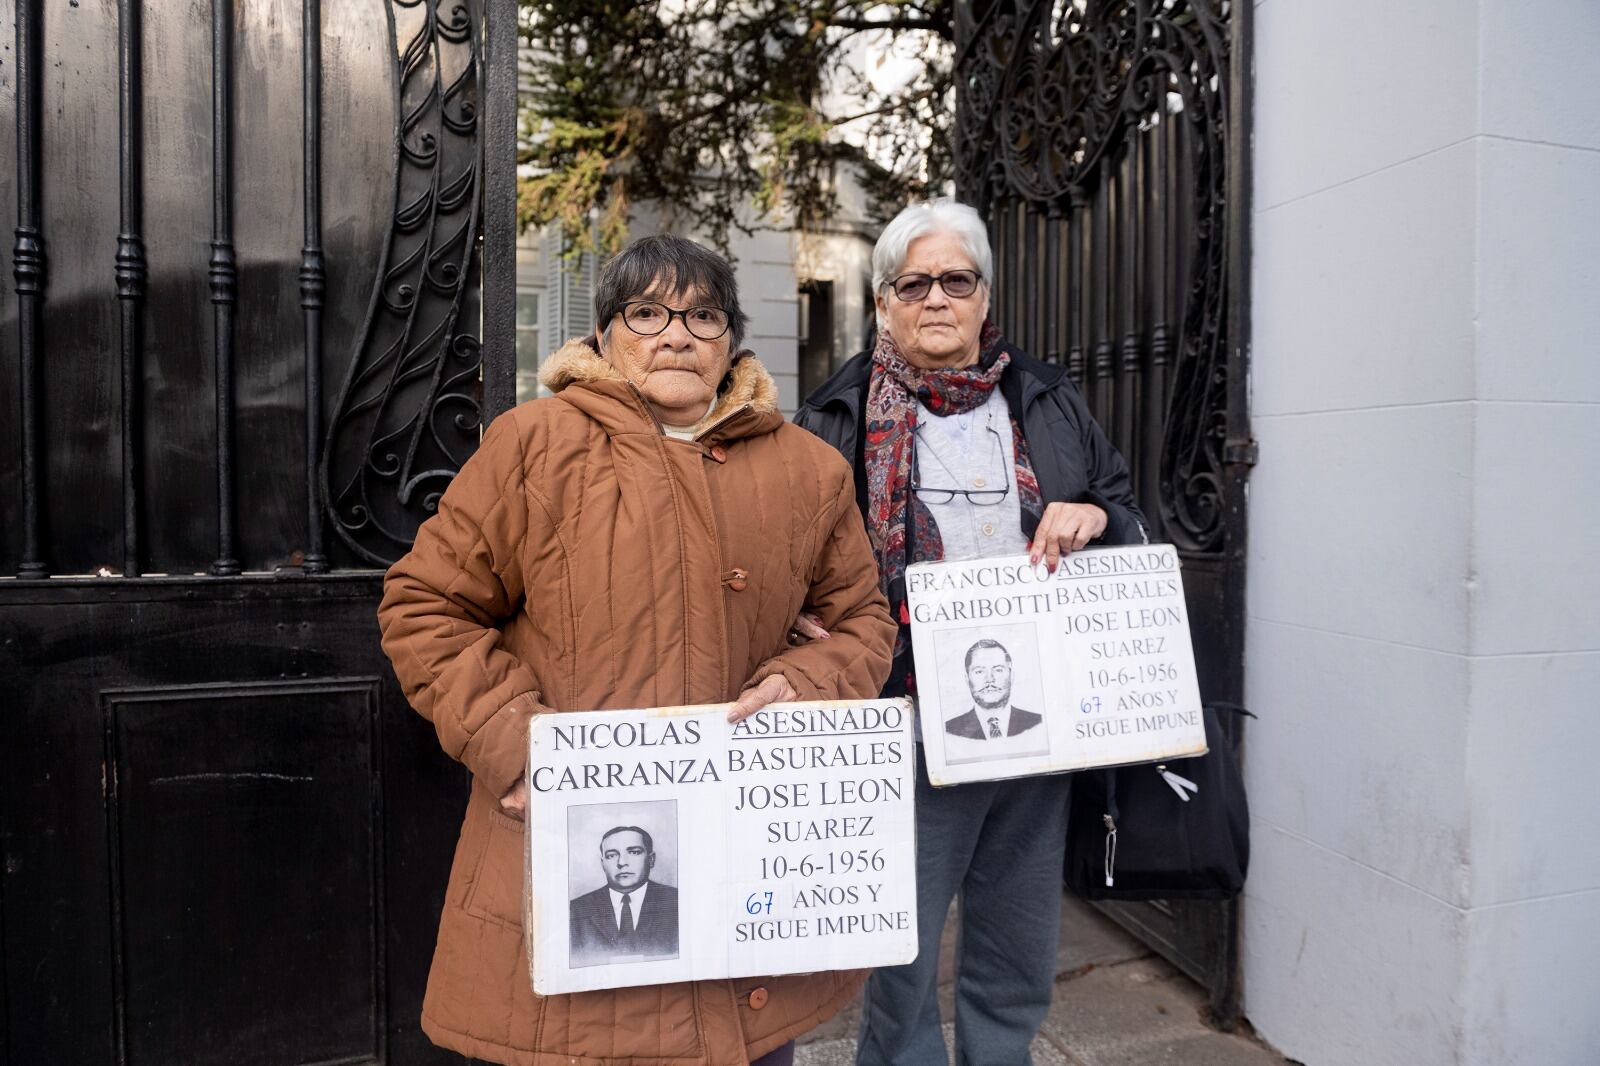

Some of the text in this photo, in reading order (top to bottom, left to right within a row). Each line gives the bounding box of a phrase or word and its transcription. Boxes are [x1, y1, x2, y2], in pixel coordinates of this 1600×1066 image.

[909, 564, 1051, 593] FRANCISCO
[1057, 552, 1175, 577] ASESINADO
[1056, 579, 1178, 606] BASURALES
[914, 593, 1051, 623] GARIBOTTI
[1065, 606, 1182, 635] JOSE LEON
[1091, 636, 1167, 660] SUAREZ
[1088, 662, 1178, 690] 10-6-1956
[1080, 689, 1179, 713] 67 AÑOS Y
[552, 719, 702, 751] NICOLAS
[731, 706, 904, 736] ASESINADO
[1075, 710, 1200, 740] SIGUE IMPUNE
[727, 741, 903, 772] BASURALES
[532, 758, 722, 793] CARRANZA
[735, 777, 904, 811] JOSE LEON
[767, 815, 875, 843] SUAREZ
[760, 848, 886, 880] 10-6-1956
[746, 883, 883, 915] 67 AÑOS Y
[735, 911, 910, 942] SIGUE IMPUNE
